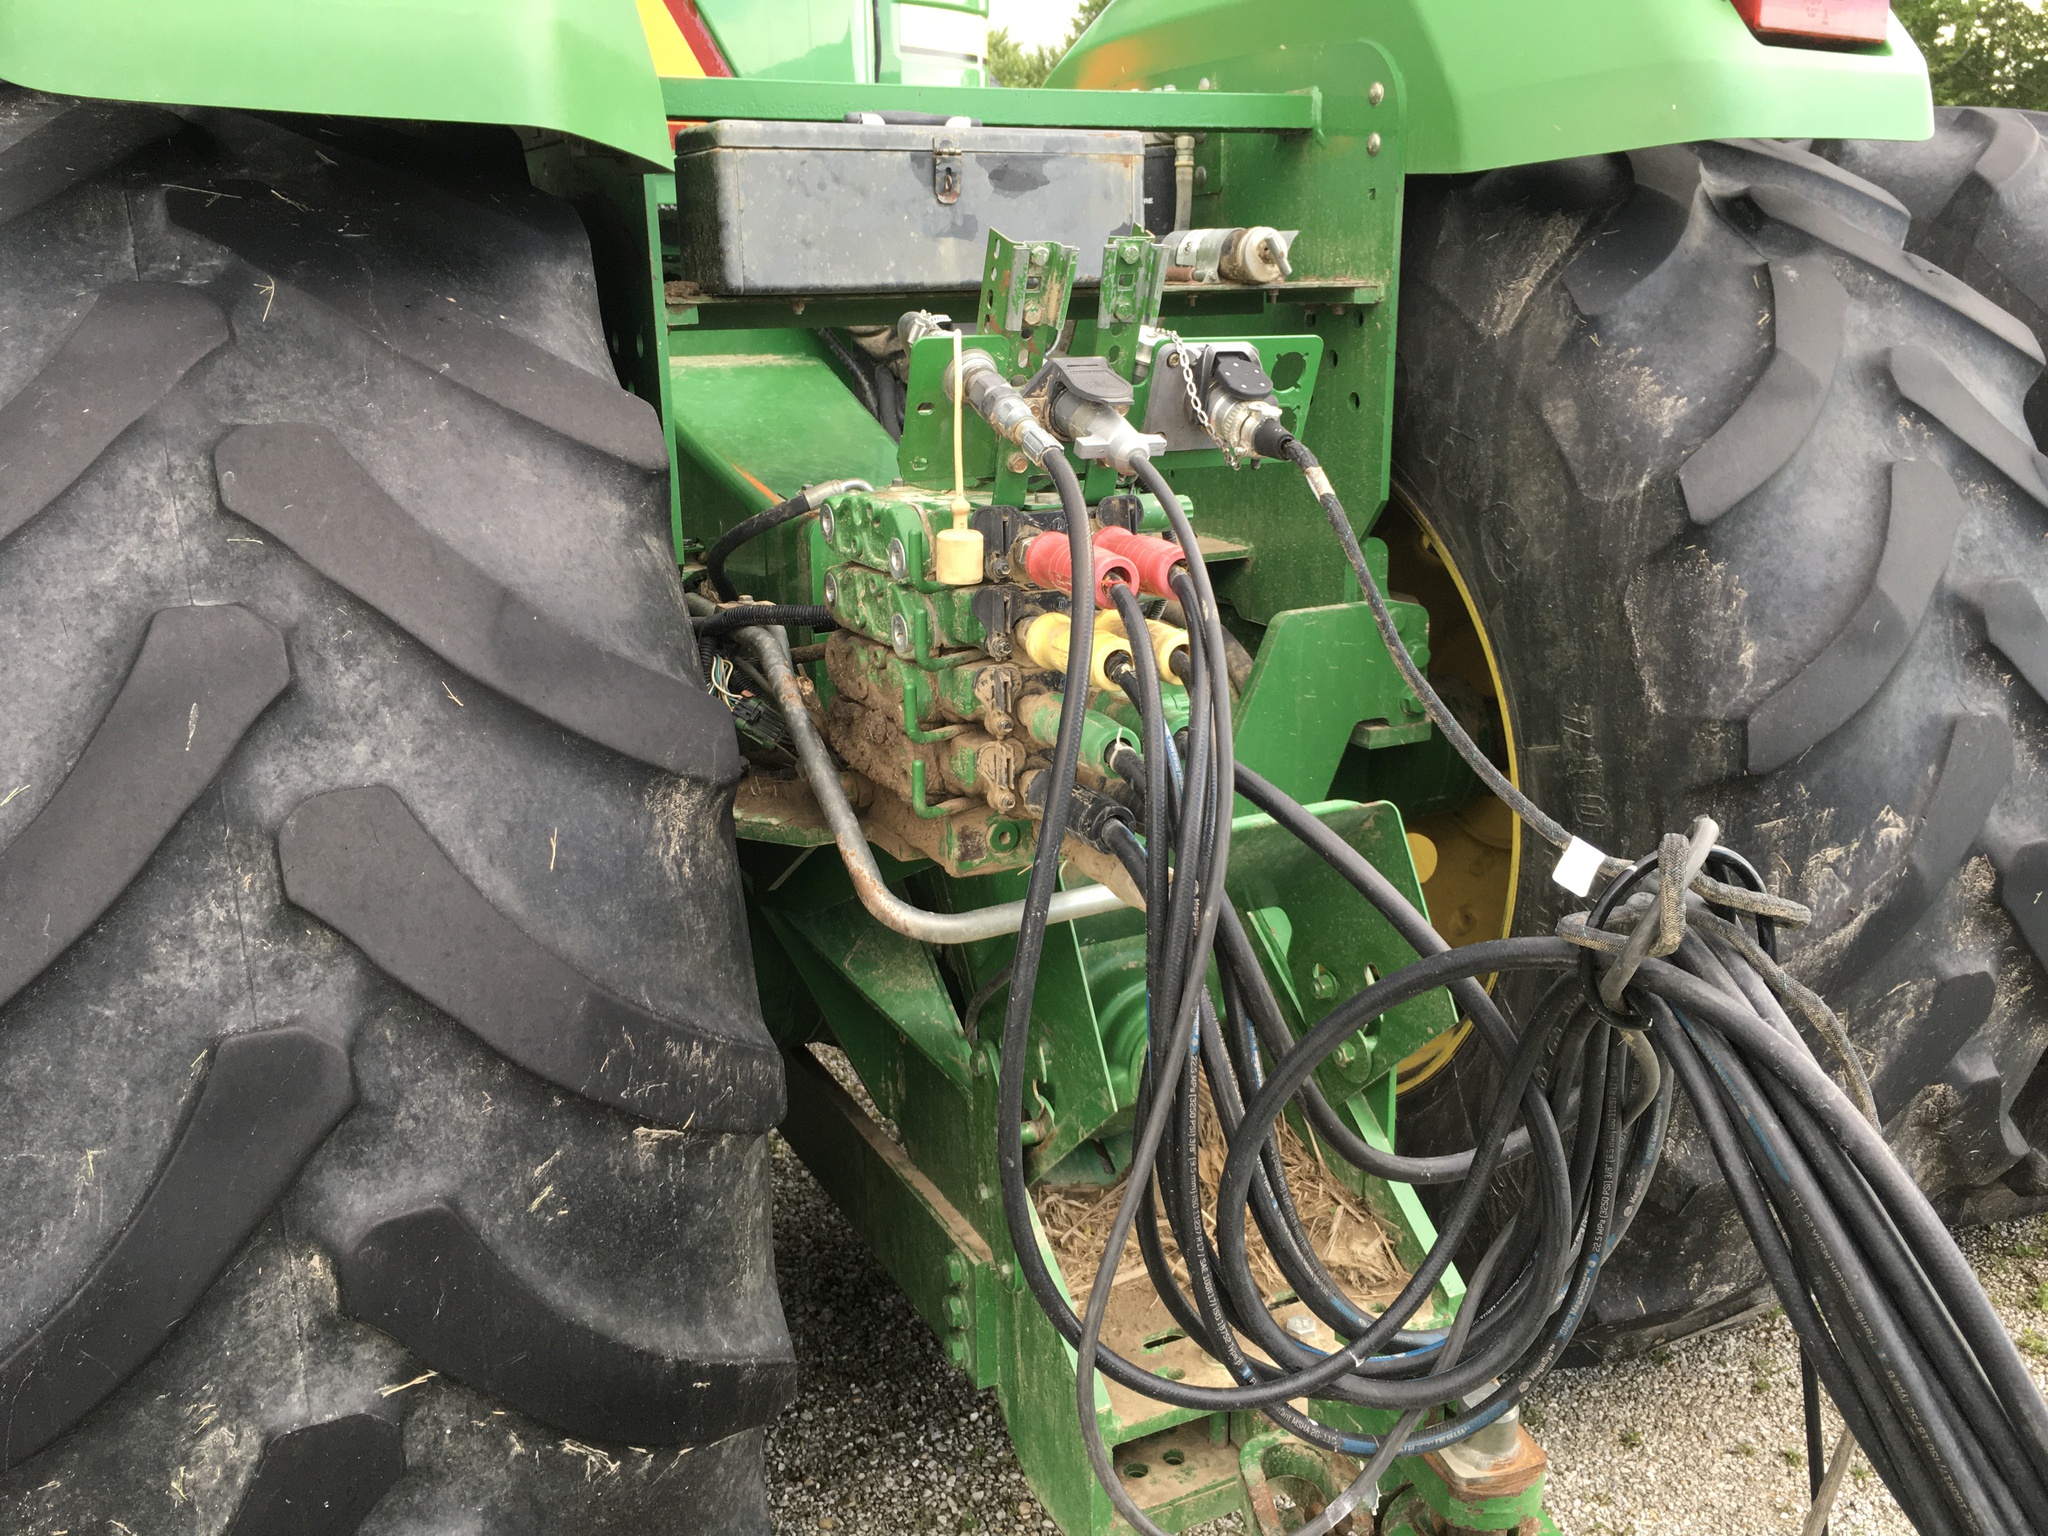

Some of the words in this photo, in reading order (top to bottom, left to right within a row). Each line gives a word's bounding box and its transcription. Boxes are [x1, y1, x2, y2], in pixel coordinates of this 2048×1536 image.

[1190, 1055, 1198, 1073] 22.5
[1191, 1194, 1200, 1209] ISO
[1192, 1209, 1203, 1235] 11237
[1596, 1217, 1606, 1236] MPa
[1196, 1235, 1205, 1252] R17
[1811, 1228, 1832, 1260] MSHA
[1200, 1258, 1210, 1274] SAE
[1211, 1306, 1223, 1321] ISO
[1217, 1320, 1233, 1345] 18752
[1291, 1416, 1311, 1433] MSHA
[1925, 1443, 1943, 1463] ISO
